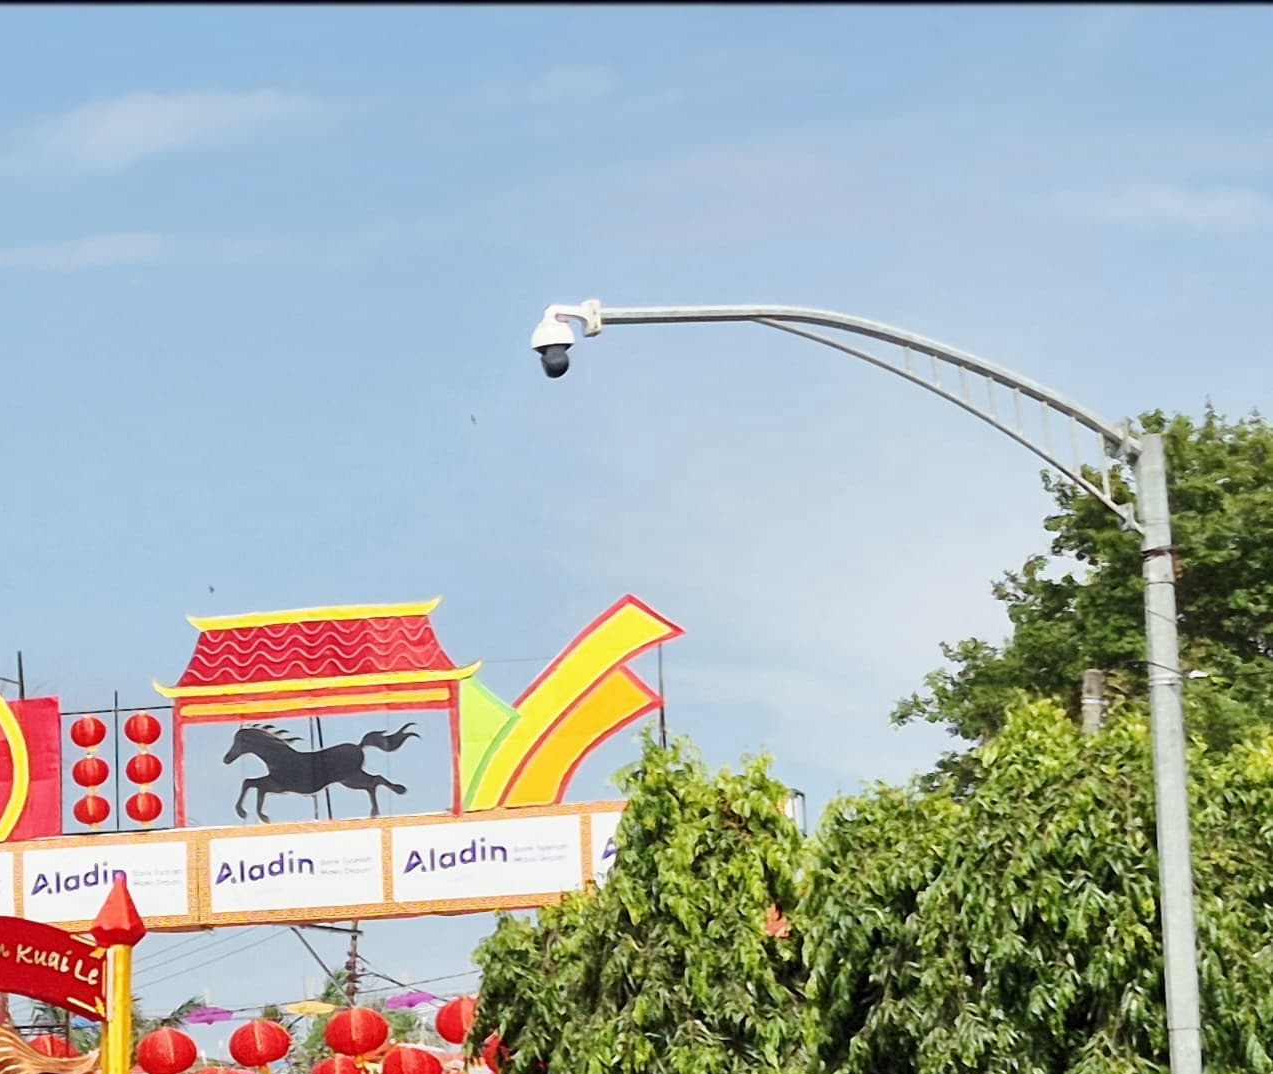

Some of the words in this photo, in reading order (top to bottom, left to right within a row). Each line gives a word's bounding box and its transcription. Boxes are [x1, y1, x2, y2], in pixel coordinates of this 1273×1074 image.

[215, 850, 315, 885] Aladin
[403, 837, 508, 874] Aladin
[15, 943, 73, 974] Kuai
[74, 959, 100, 986] Le
